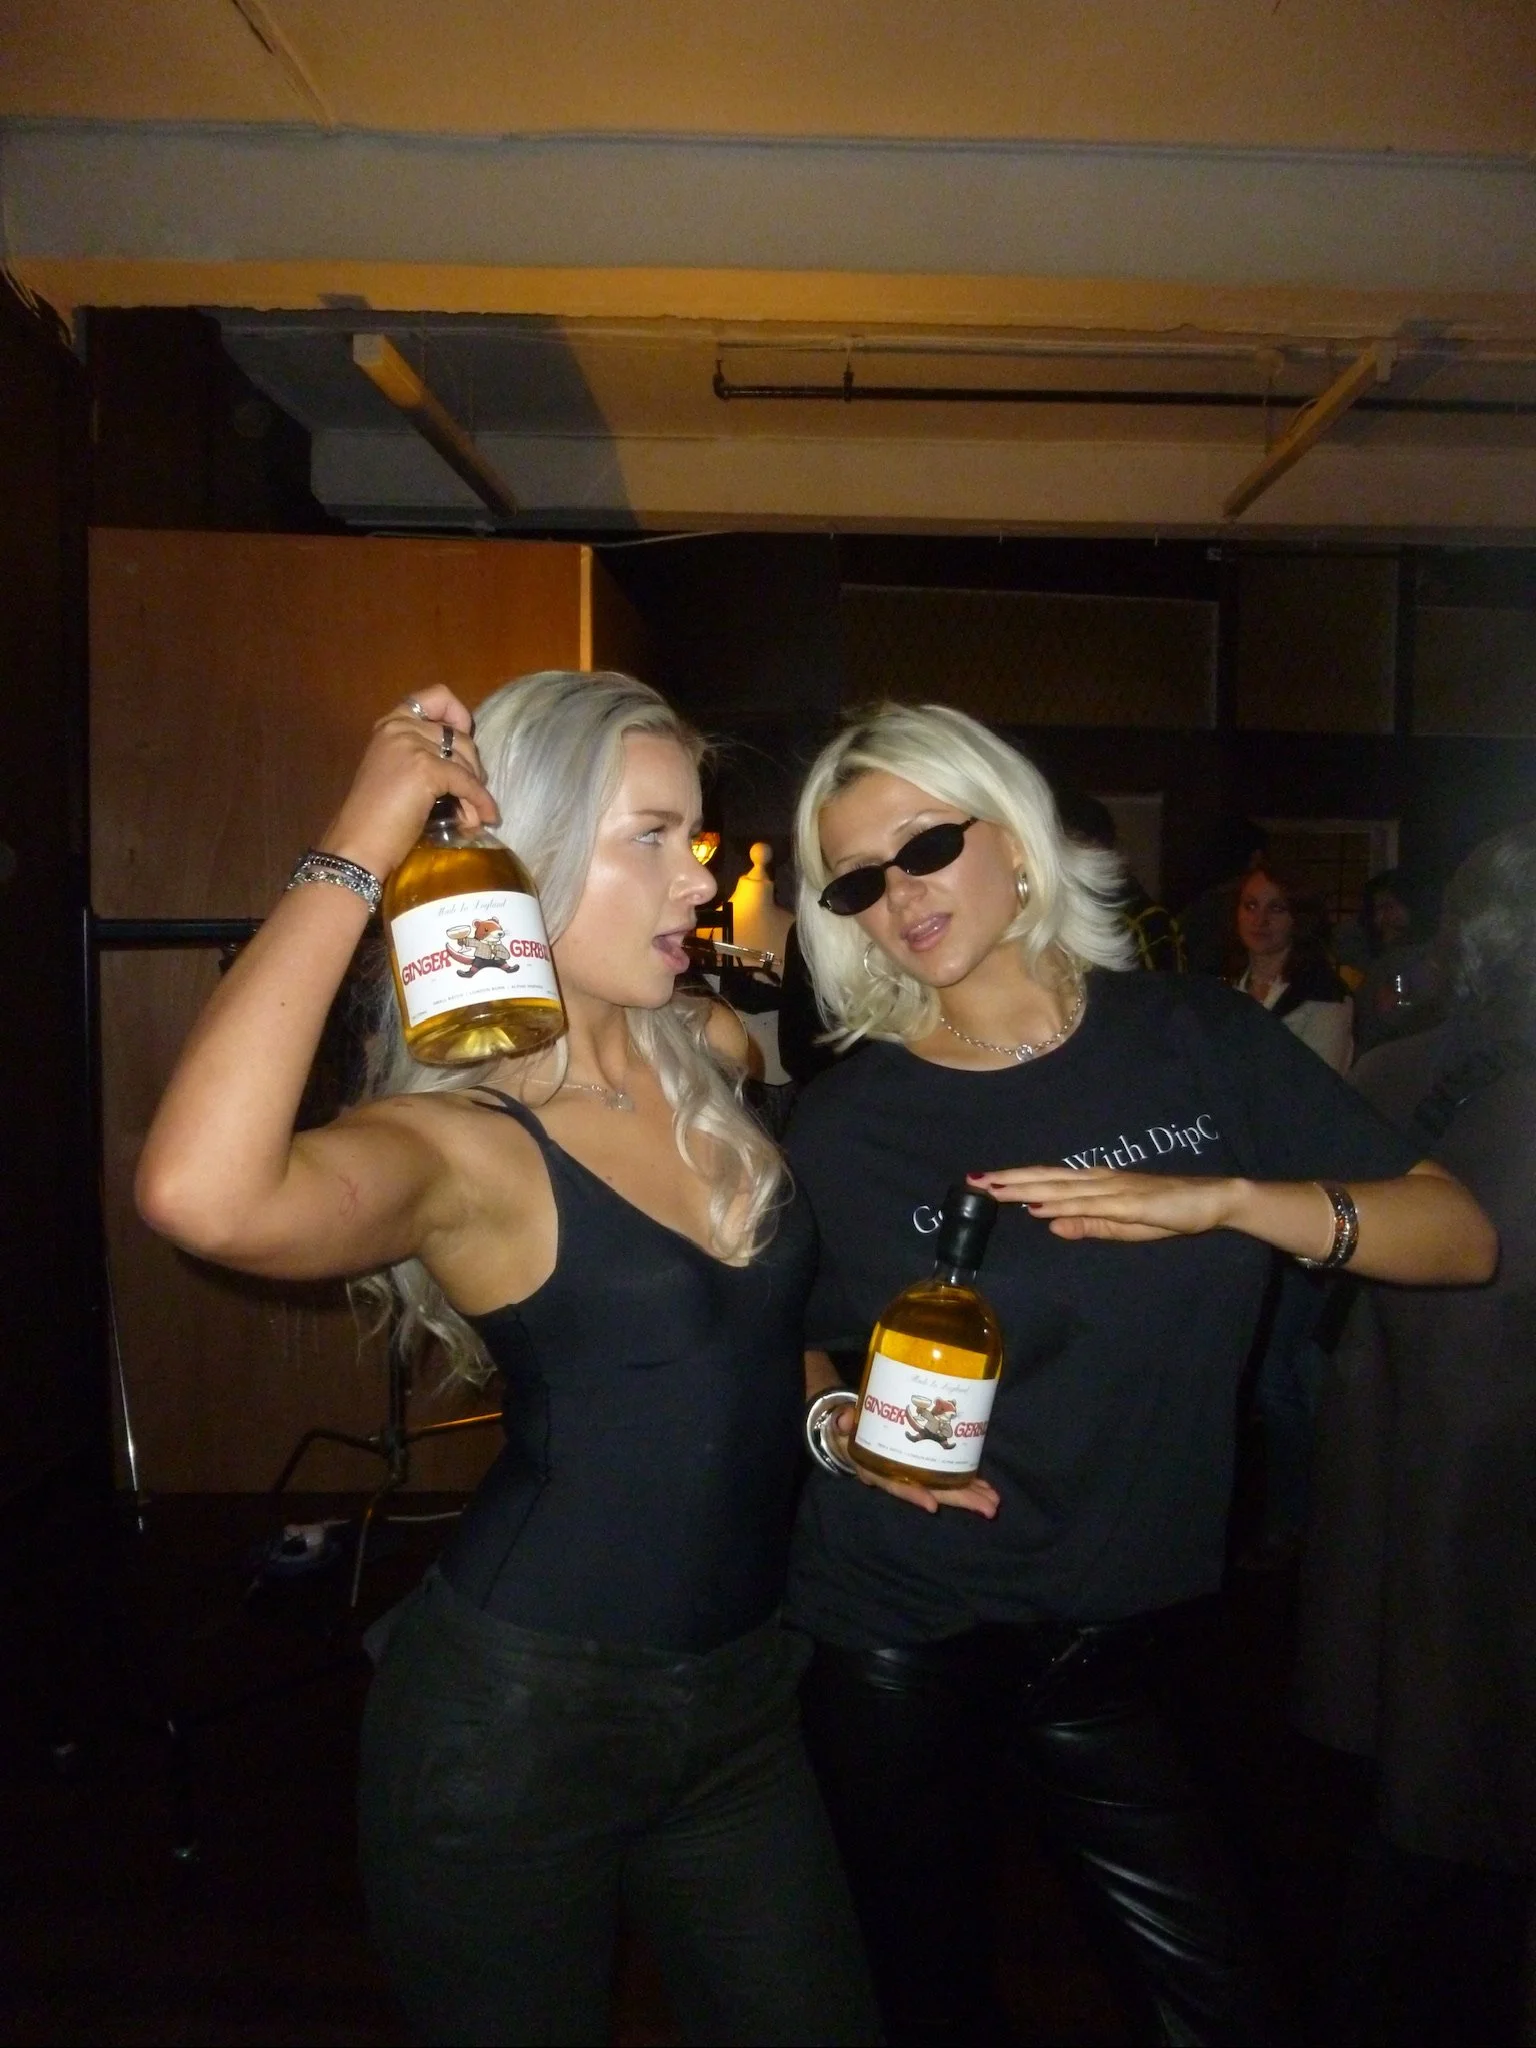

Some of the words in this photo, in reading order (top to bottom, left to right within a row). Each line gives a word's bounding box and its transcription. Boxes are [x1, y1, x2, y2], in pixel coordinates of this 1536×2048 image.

[401, 949, 452, 986] GINGER
[1061, 1134, 1148, 1171] With
[1145, 1113, 1220, 1156] DipC
[864, 1394, 907, 1426] GINGER
